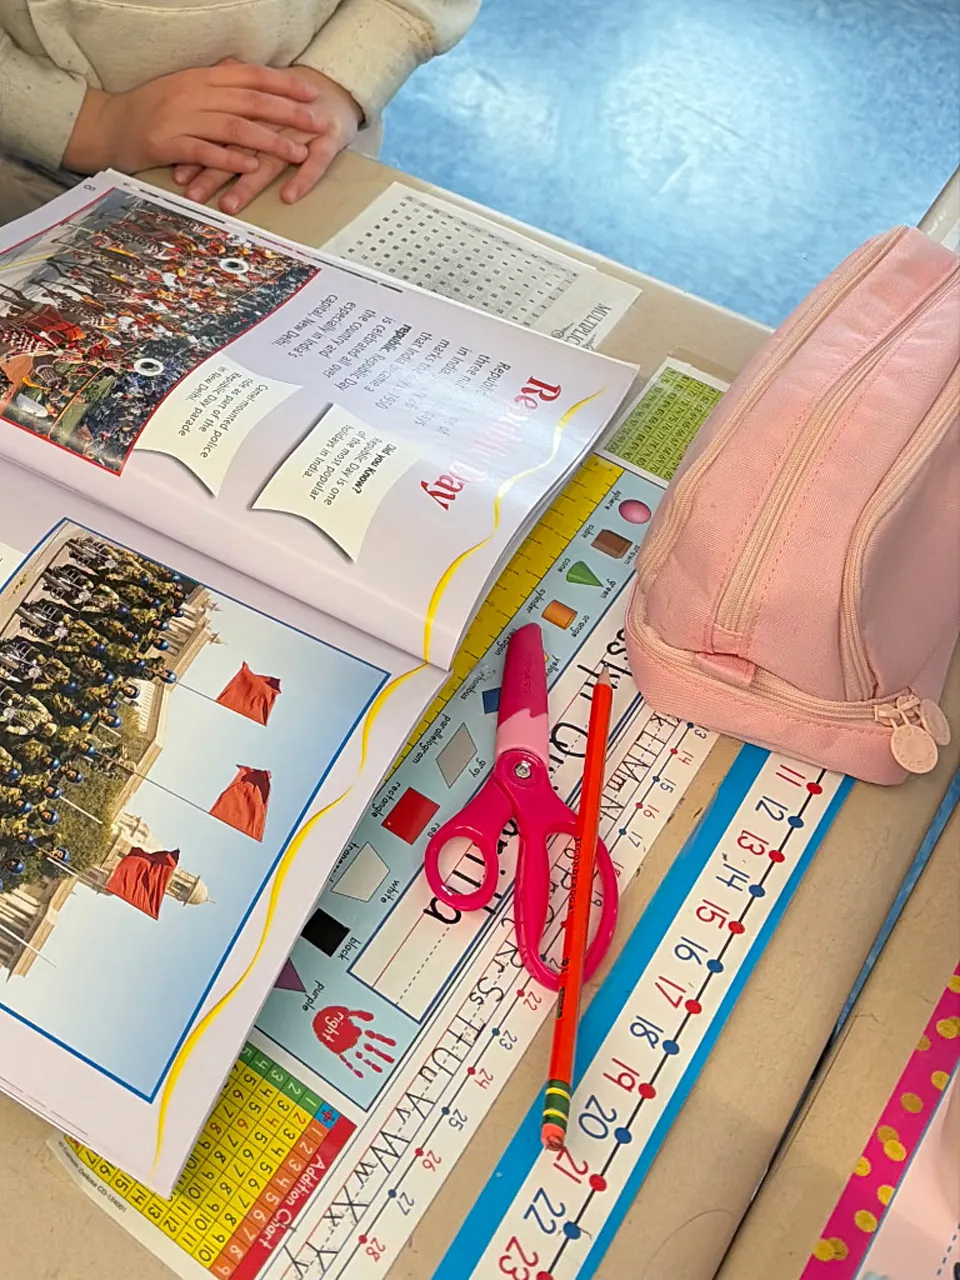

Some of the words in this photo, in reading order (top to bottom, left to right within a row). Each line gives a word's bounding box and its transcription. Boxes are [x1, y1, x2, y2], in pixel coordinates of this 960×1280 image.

[316, 302, 356, 333] especially
[357, 309, 376, 322] the
[568, 302, 612, 347] MULTIPLIC
[311, 331, 327, 339] in
[330, 321, 363, 347] country
[287, 338, 319, 358] India's
[318, 344, 337, 359] and
[212, 372, 243, 395] Republic
[199, 394, 218, 408] Day
[219, 384, 269, 432] Camel-mounted
[178, 406, 203, 436] parade
[199, 429, 222, 458] police
[326, 424, 355, 449] holidays
[346, 437, 361, 448] the
[356, 430, 366, 440] of
[319, 448, 333, 457] in
[331, 447, 350, 466] most
[353, 437, 383, 463] Republic
[370, 452, 386, 467] you
[381, 443, 397, 456] Did
[302, 456, 325, 478] India.
[339, 462, 360, 478] Day
[351, 467, 377, 494] Know?
[309, 465, 335, 501] popular
[336, 477, 349, 487] is
[323, 487, 340, 506] one
[461, 672, 484, 700] rhombus
[412, 713, 451, 764] parallelogram
[775, 764, 806, 787] 11
[371, 782, 401, 818] rectangle
[755, 795, 789, 822] 12
[736, 829, 769, 856] 13
[715, 863, 750, 892] 14
[380, 880, 400, 904] white
[695, 899, 730, 929] 15
[339, 936, 362, 961] black
[674, 936, 709, 965] 16
[302, 980, 325, 1012] purple
[654, 976, 687, 1009] 17
[322, 1011, 345, 1043] right
[629, 1015, 664, 1049] 18
[602, 1057, 641, 1093] 19
[578, 1094, 618, 1140] 20
[552, 1147, 589, 1185] 21
[289, 1154, 326, 1207] Addition
[523, 1187, 566, 1235] 22
[261, 1207, 294, 1251] Chart
[498, 1236, 539, 1280] 23
